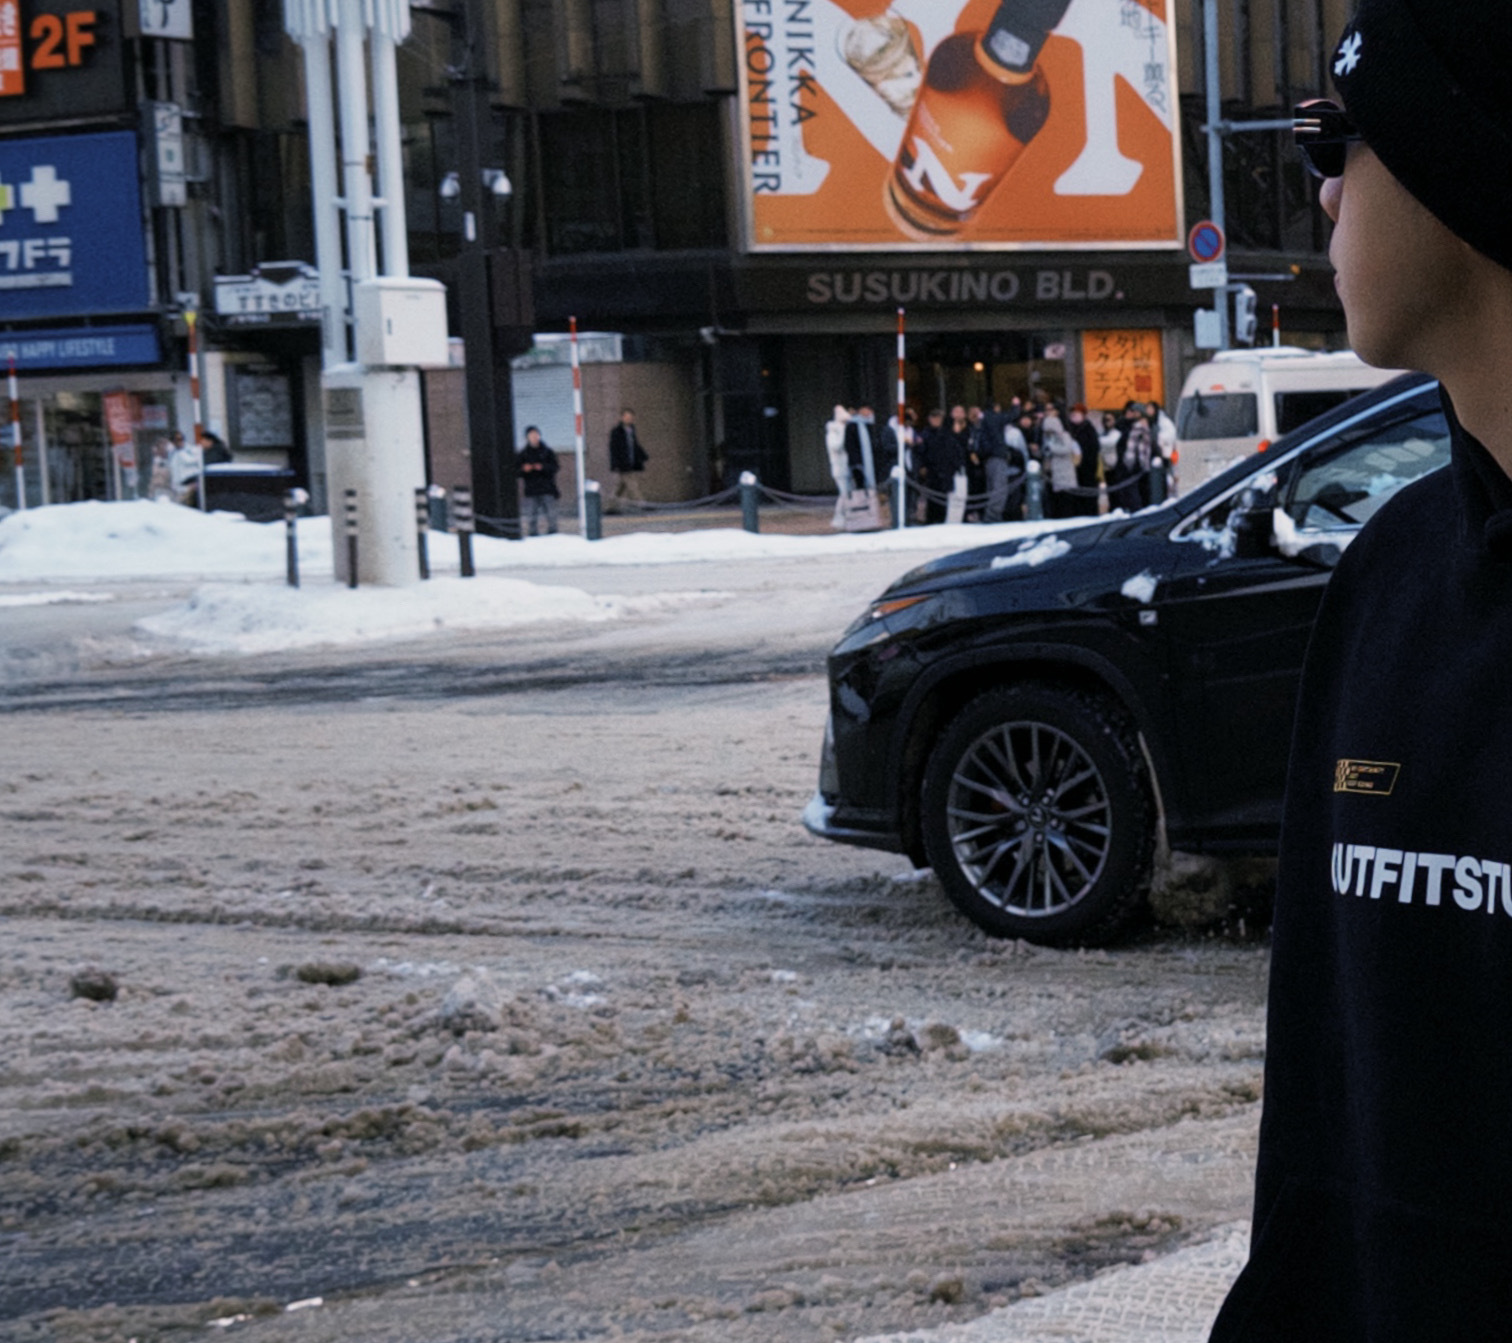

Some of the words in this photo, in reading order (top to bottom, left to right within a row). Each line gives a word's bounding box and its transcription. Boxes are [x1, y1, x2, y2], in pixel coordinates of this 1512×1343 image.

[31, 10, 97, 70] 2F
[807, 270, 1019, 303] SUSUKINO
[1036, 270, 1126, 301] BLD.
[58, 337, 117, 358] LIFESTYLE
